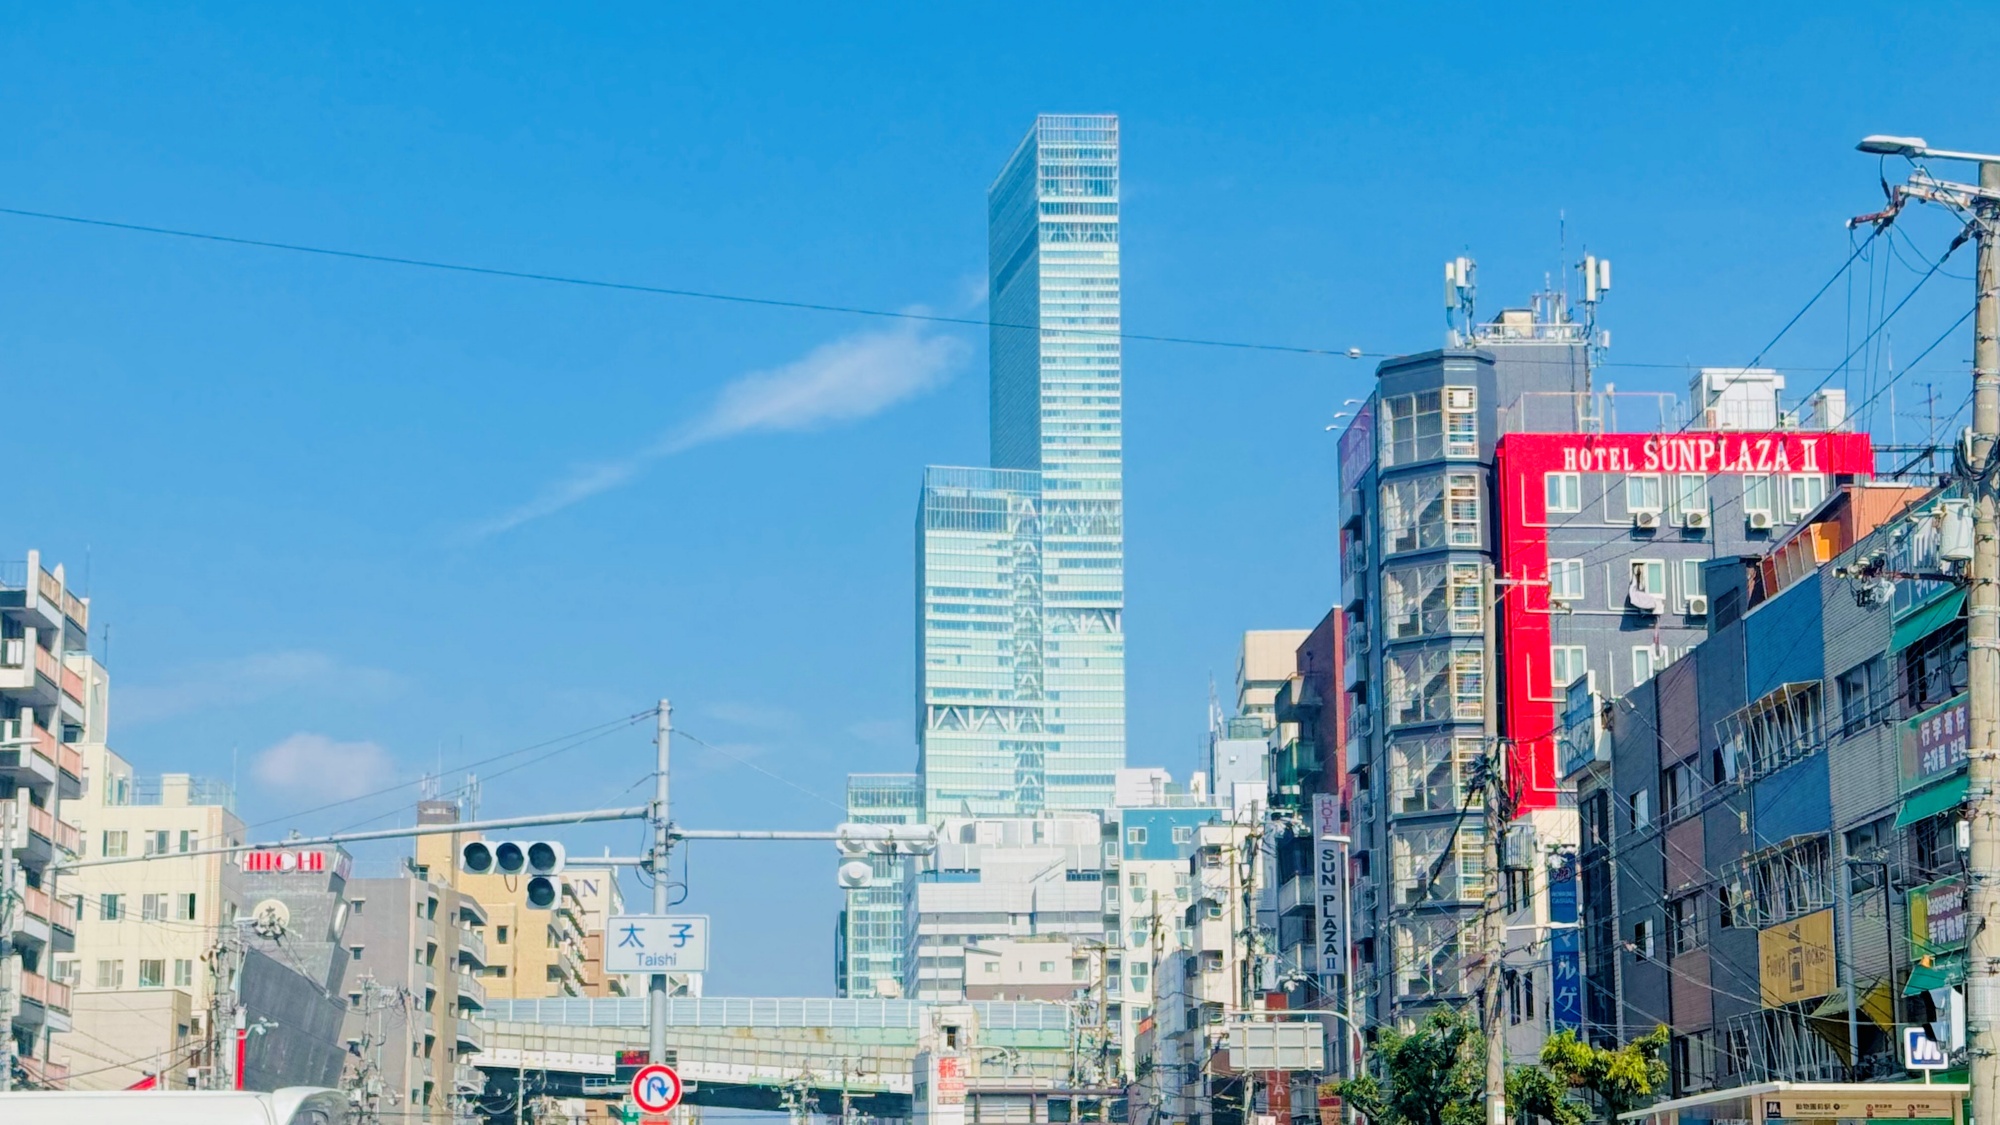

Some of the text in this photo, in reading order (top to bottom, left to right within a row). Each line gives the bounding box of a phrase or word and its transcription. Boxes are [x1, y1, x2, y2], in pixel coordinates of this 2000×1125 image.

[1563, 447, 1635, 471] HOTEL
[1643, 439, 1792, 472] SUNPLAZA
[1321, 799, 1334, 841] HOTE
[1321, 848, 1336, 886] SUN
[618, 922, 695, 949] 太子
[1322, 894, 1338, 956] PLAZA
[636, 952, 677, 967] Taishi
